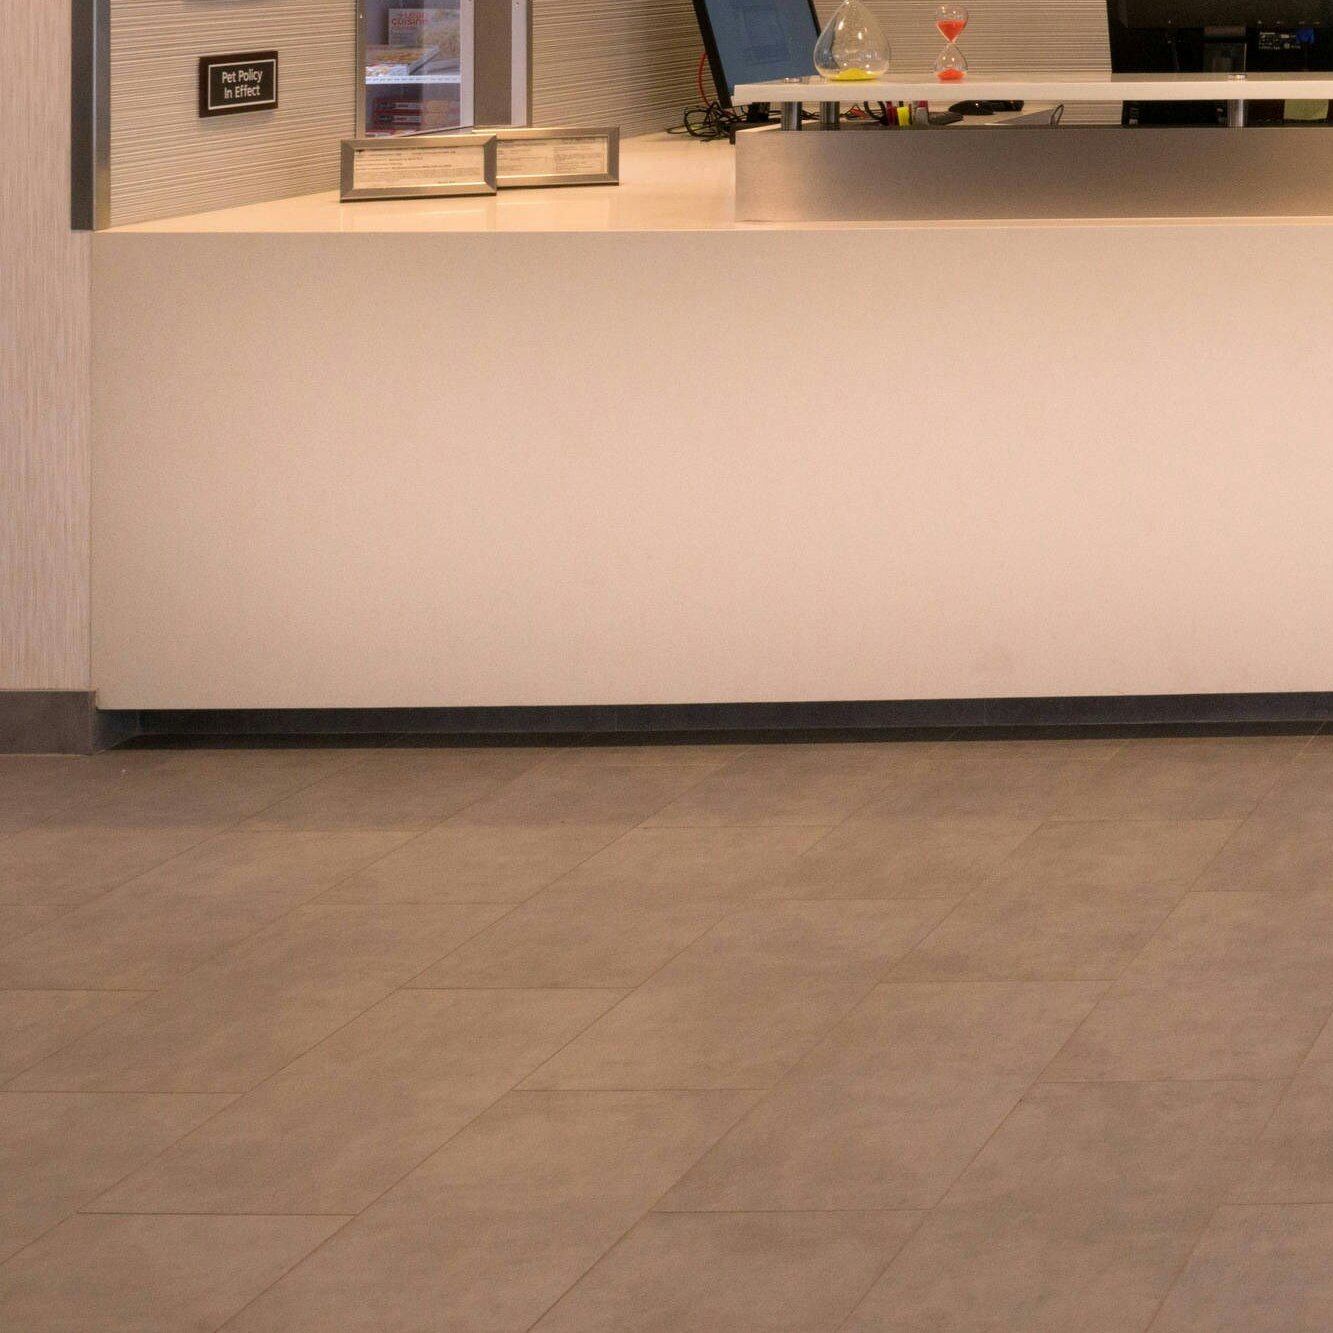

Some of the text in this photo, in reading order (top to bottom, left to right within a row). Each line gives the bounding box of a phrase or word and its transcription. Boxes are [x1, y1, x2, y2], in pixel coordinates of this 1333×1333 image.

[221, 68, 263, 84] Pet Policy
[224, 85, 260, 99] In Effect
